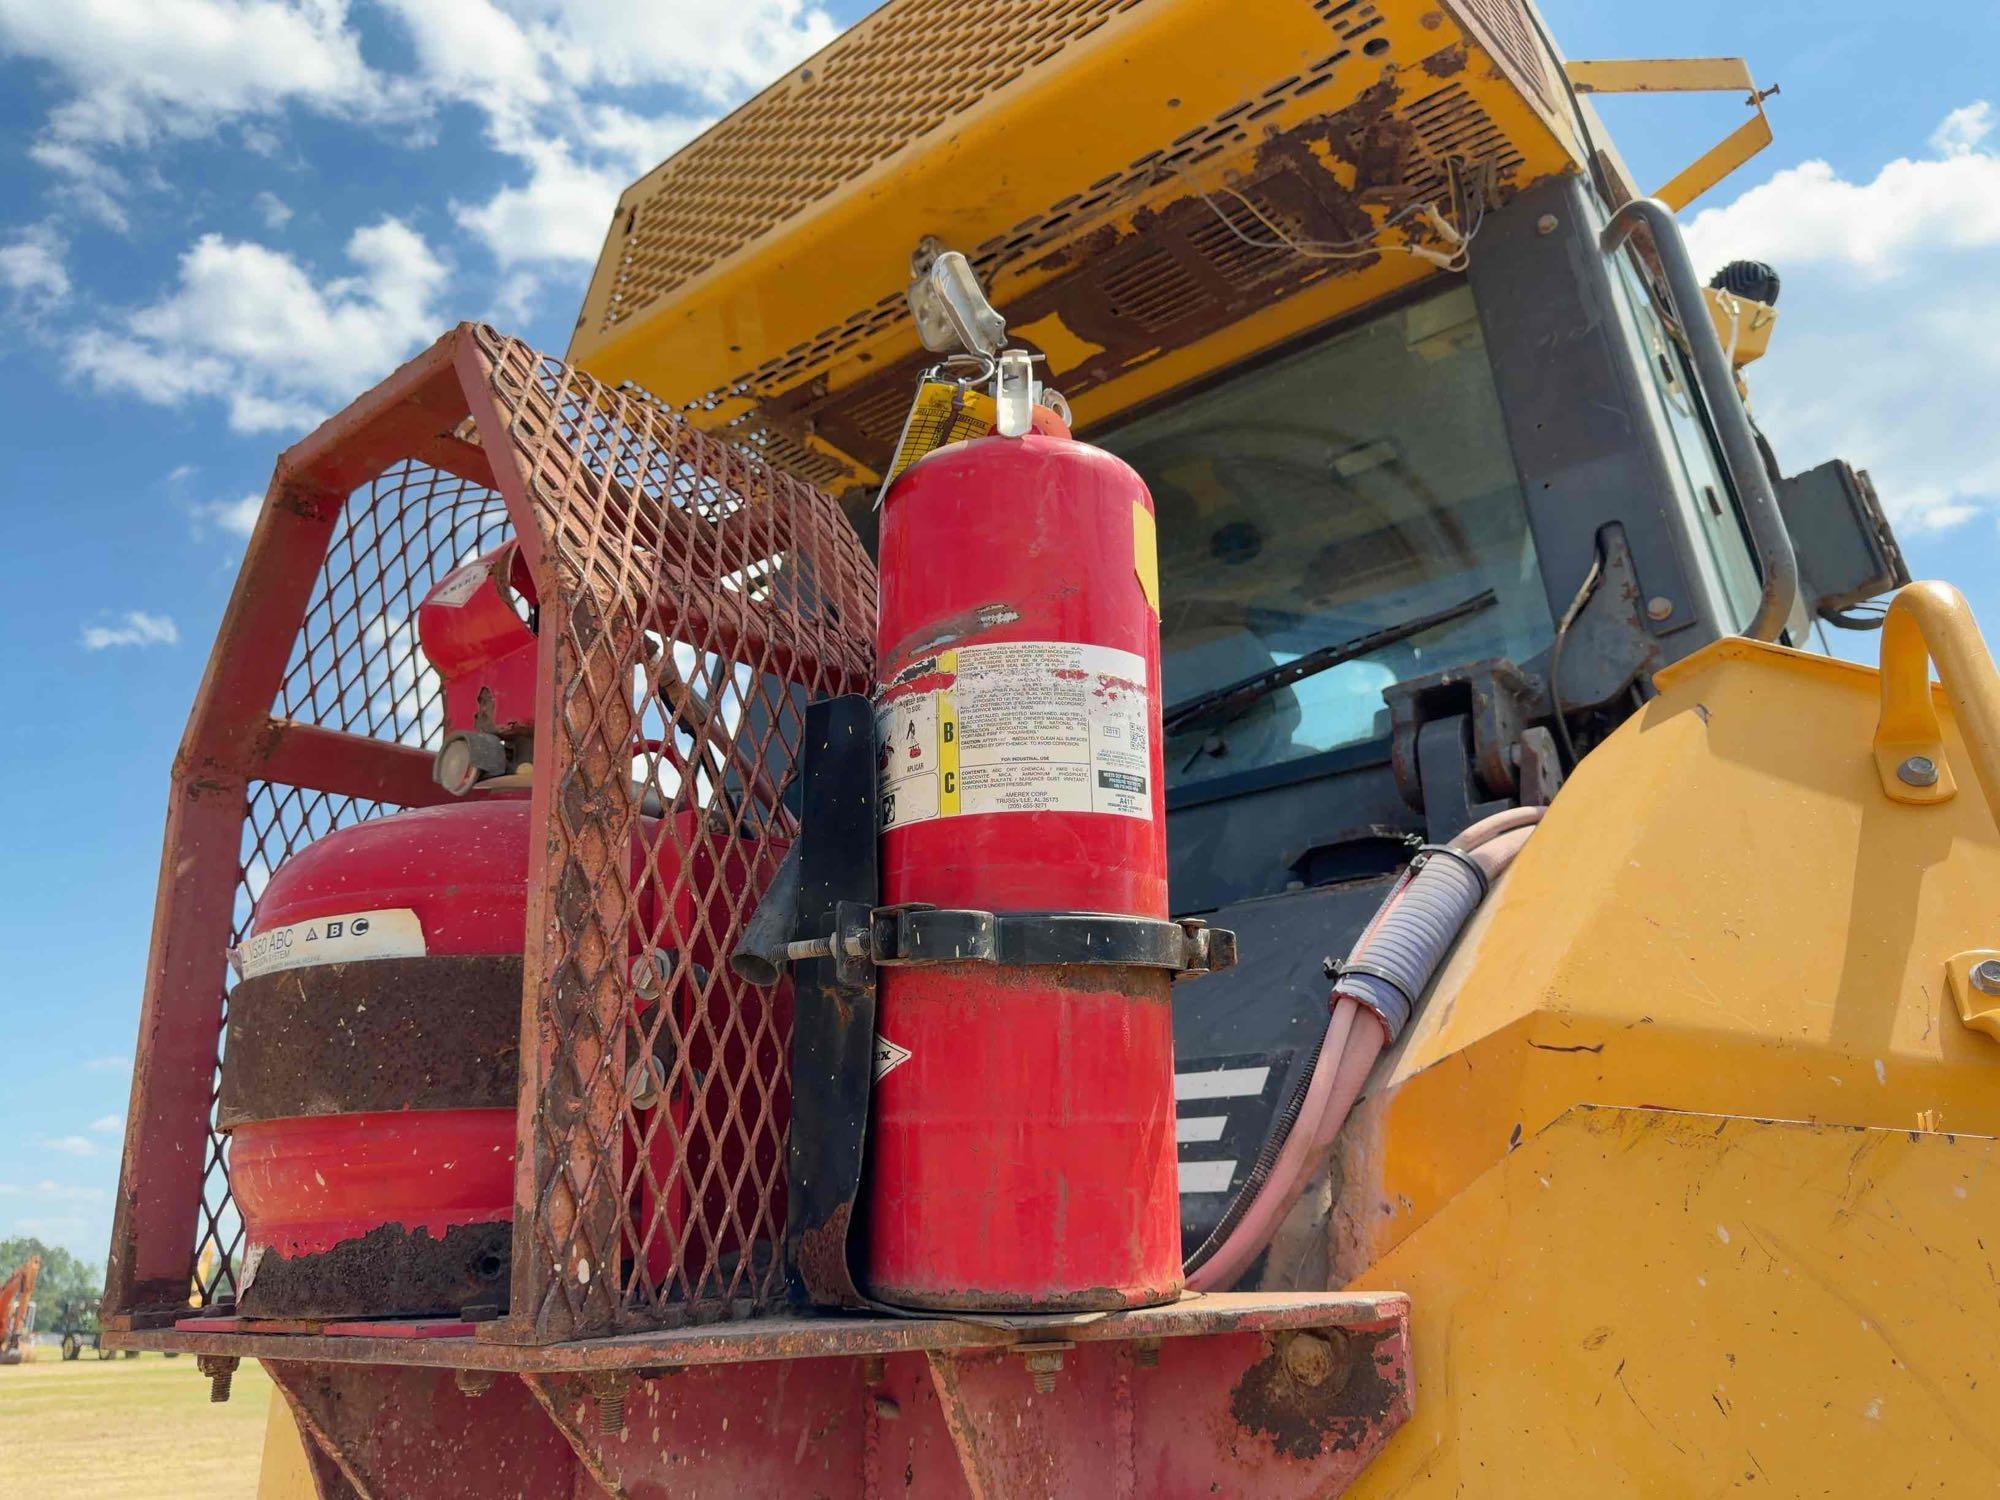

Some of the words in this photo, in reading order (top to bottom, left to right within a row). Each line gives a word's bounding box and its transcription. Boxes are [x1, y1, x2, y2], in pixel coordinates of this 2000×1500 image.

[944, 722, 953, 742] B
[907, 762, 924, 773] APLICAR
[944, 772, 955, 793] C
[269, 928, 294, 951] ABC
